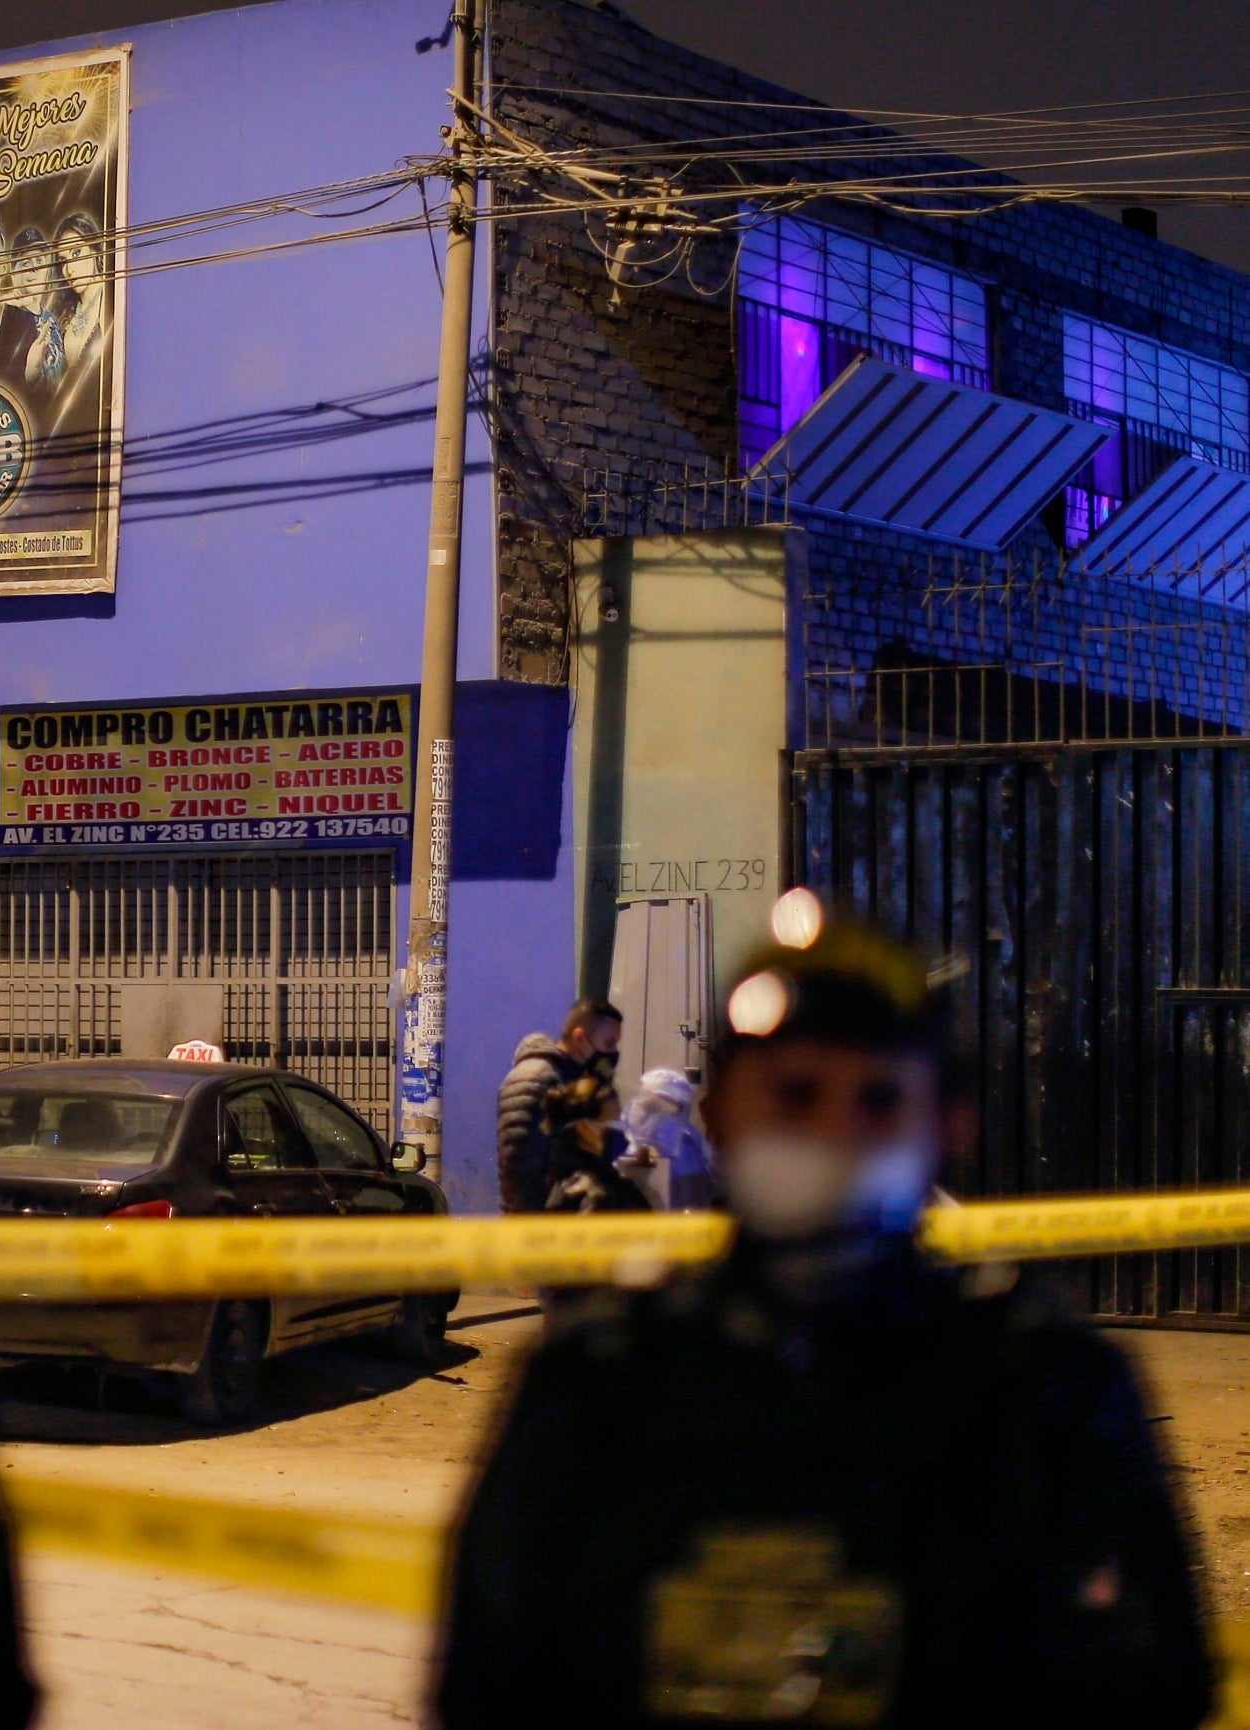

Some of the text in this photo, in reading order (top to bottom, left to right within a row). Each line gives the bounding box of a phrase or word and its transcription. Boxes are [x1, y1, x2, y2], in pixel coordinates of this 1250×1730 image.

[23, 536, 50, 553] Costado
[52, 536, 60, 551] de
[62, 535, 83, 551] Tottus
[7, 700, 403, 750] COMPRO CHATARRA
[24, 752, 122, 772] COBRE
[148, 745, 271, 768] BRONCE
[297, 739, 404, 762] ACERO
[21, 776, 142, 797] ALUMINIO
[164, 772, 251, 793] PLOMO
[274, 765, 404, 789] BATERIAS
[27, 801, 141, 821] FIERRO
[169, 798, 247, 818] ZINC
[278, 792, 404, 815] NIQUEL
[3, 816, 408, 844] AV. EL ZINC N°235 CEL:922 137540
[716, 858, 766, 891] 239
[176, 1047, 213, 1062] TAXI
